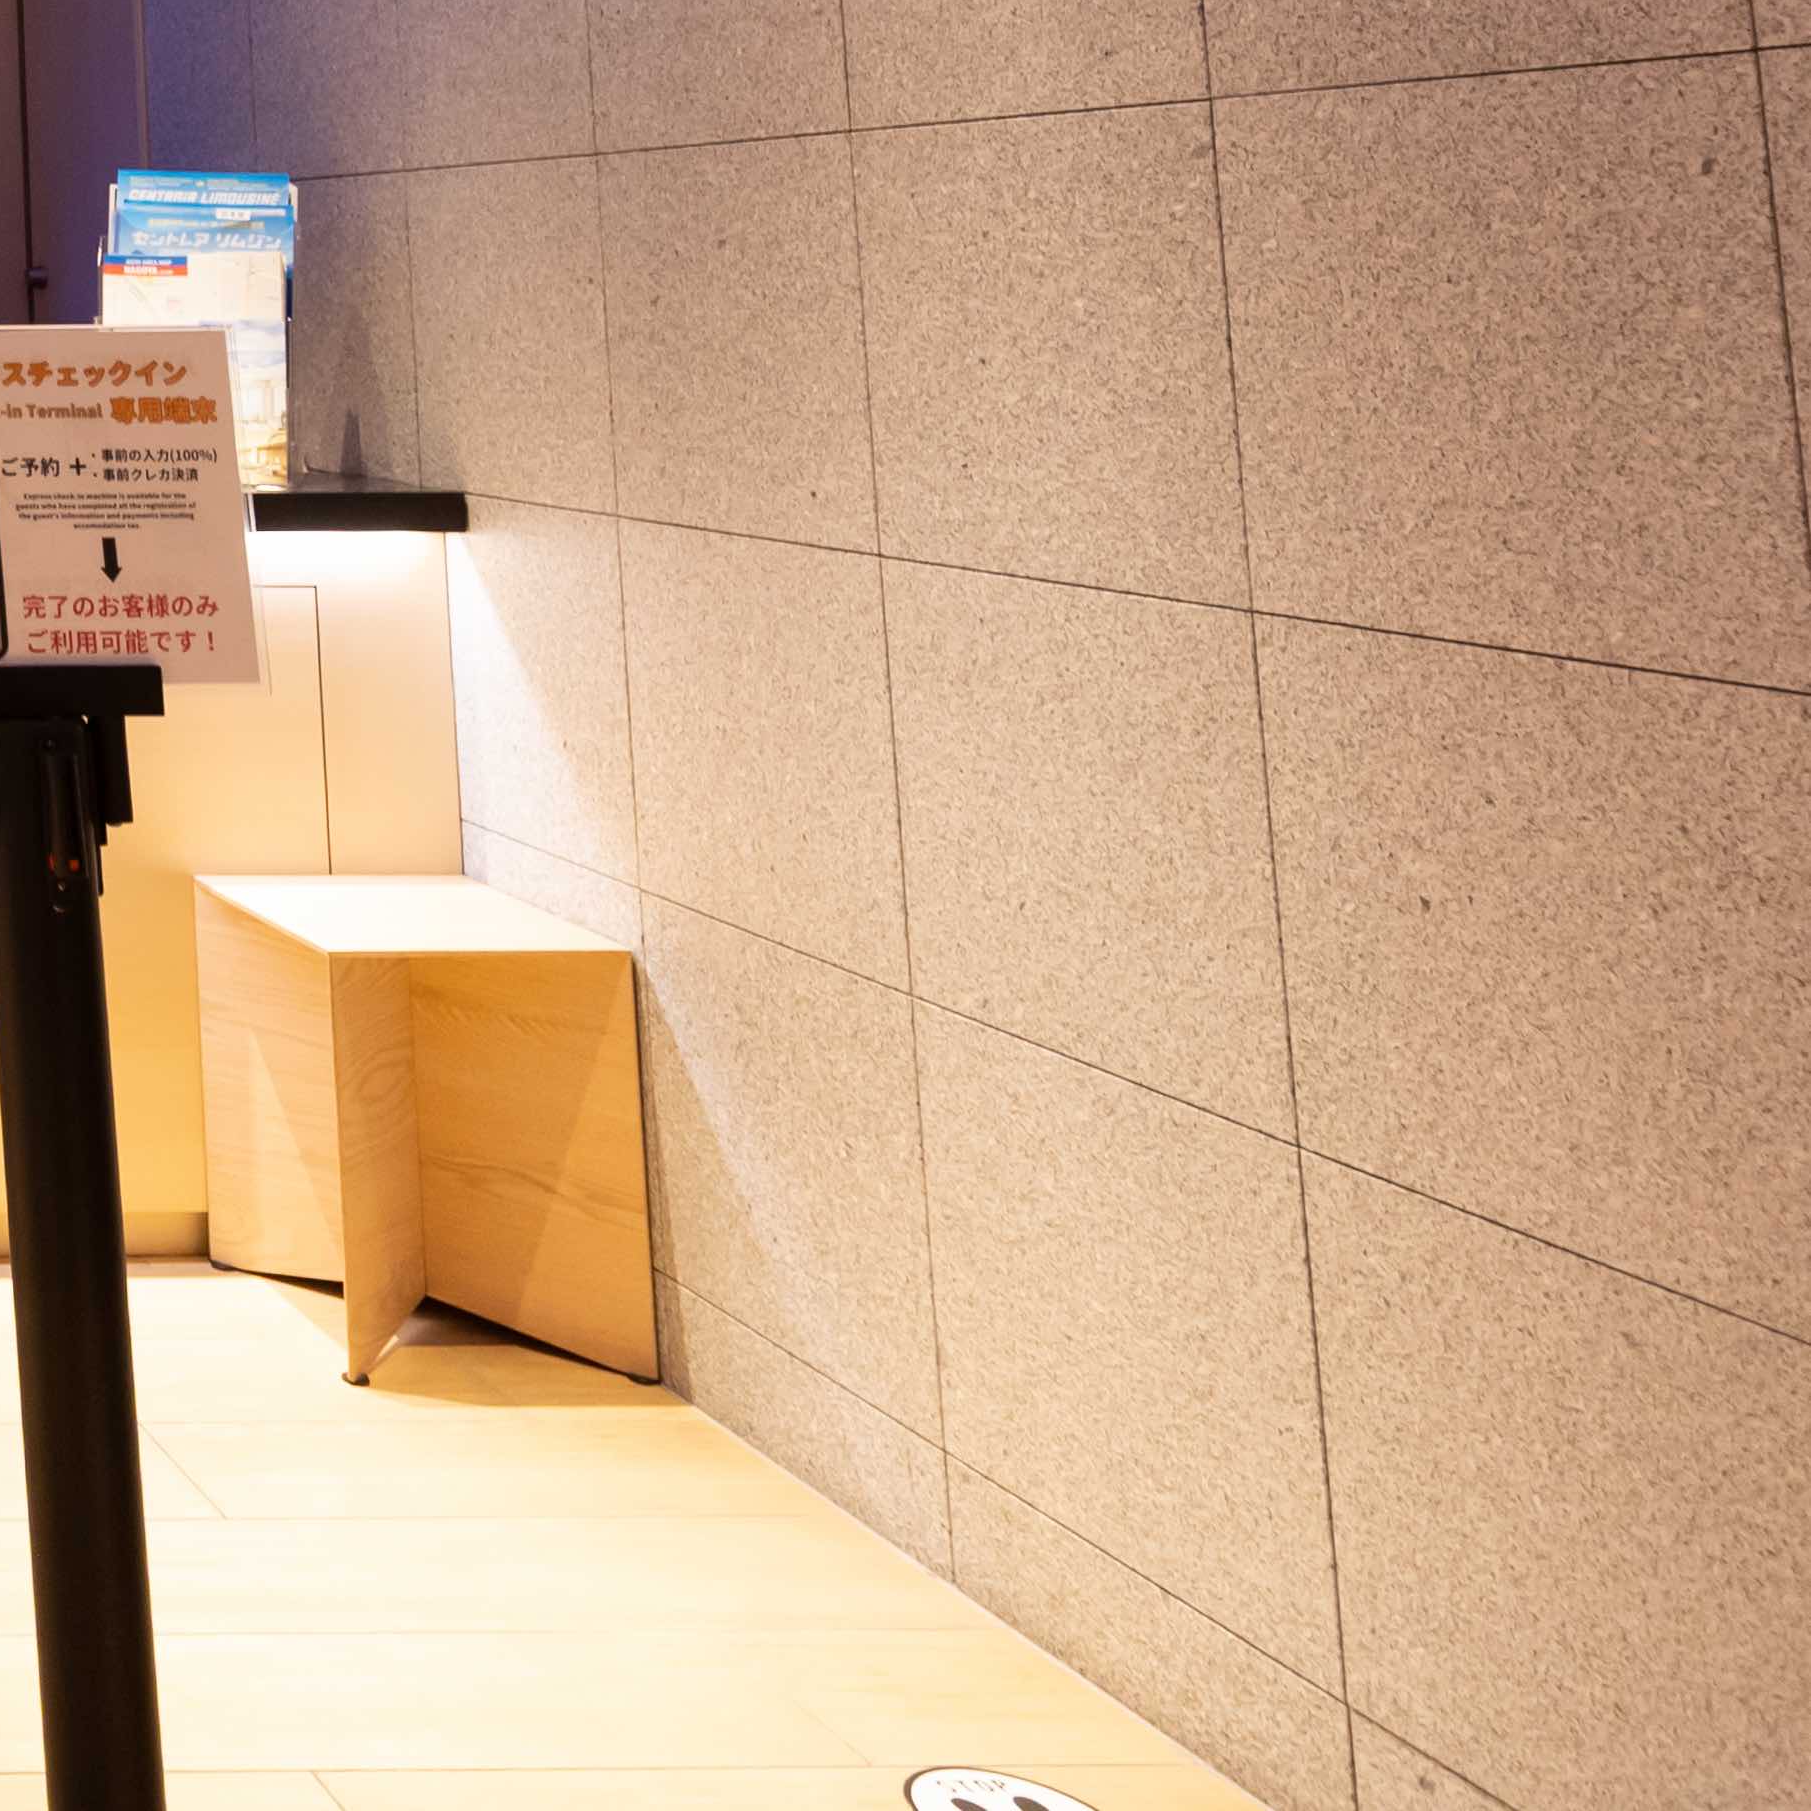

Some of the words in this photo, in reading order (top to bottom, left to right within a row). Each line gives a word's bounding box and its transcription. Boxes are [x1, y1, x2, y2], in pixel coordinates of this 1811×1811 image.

[25, 401, 104, 420] Terminal
[1, 456, 61, 478] ご予約
[22, 593, 220, 620] 完了のお客様のみ
